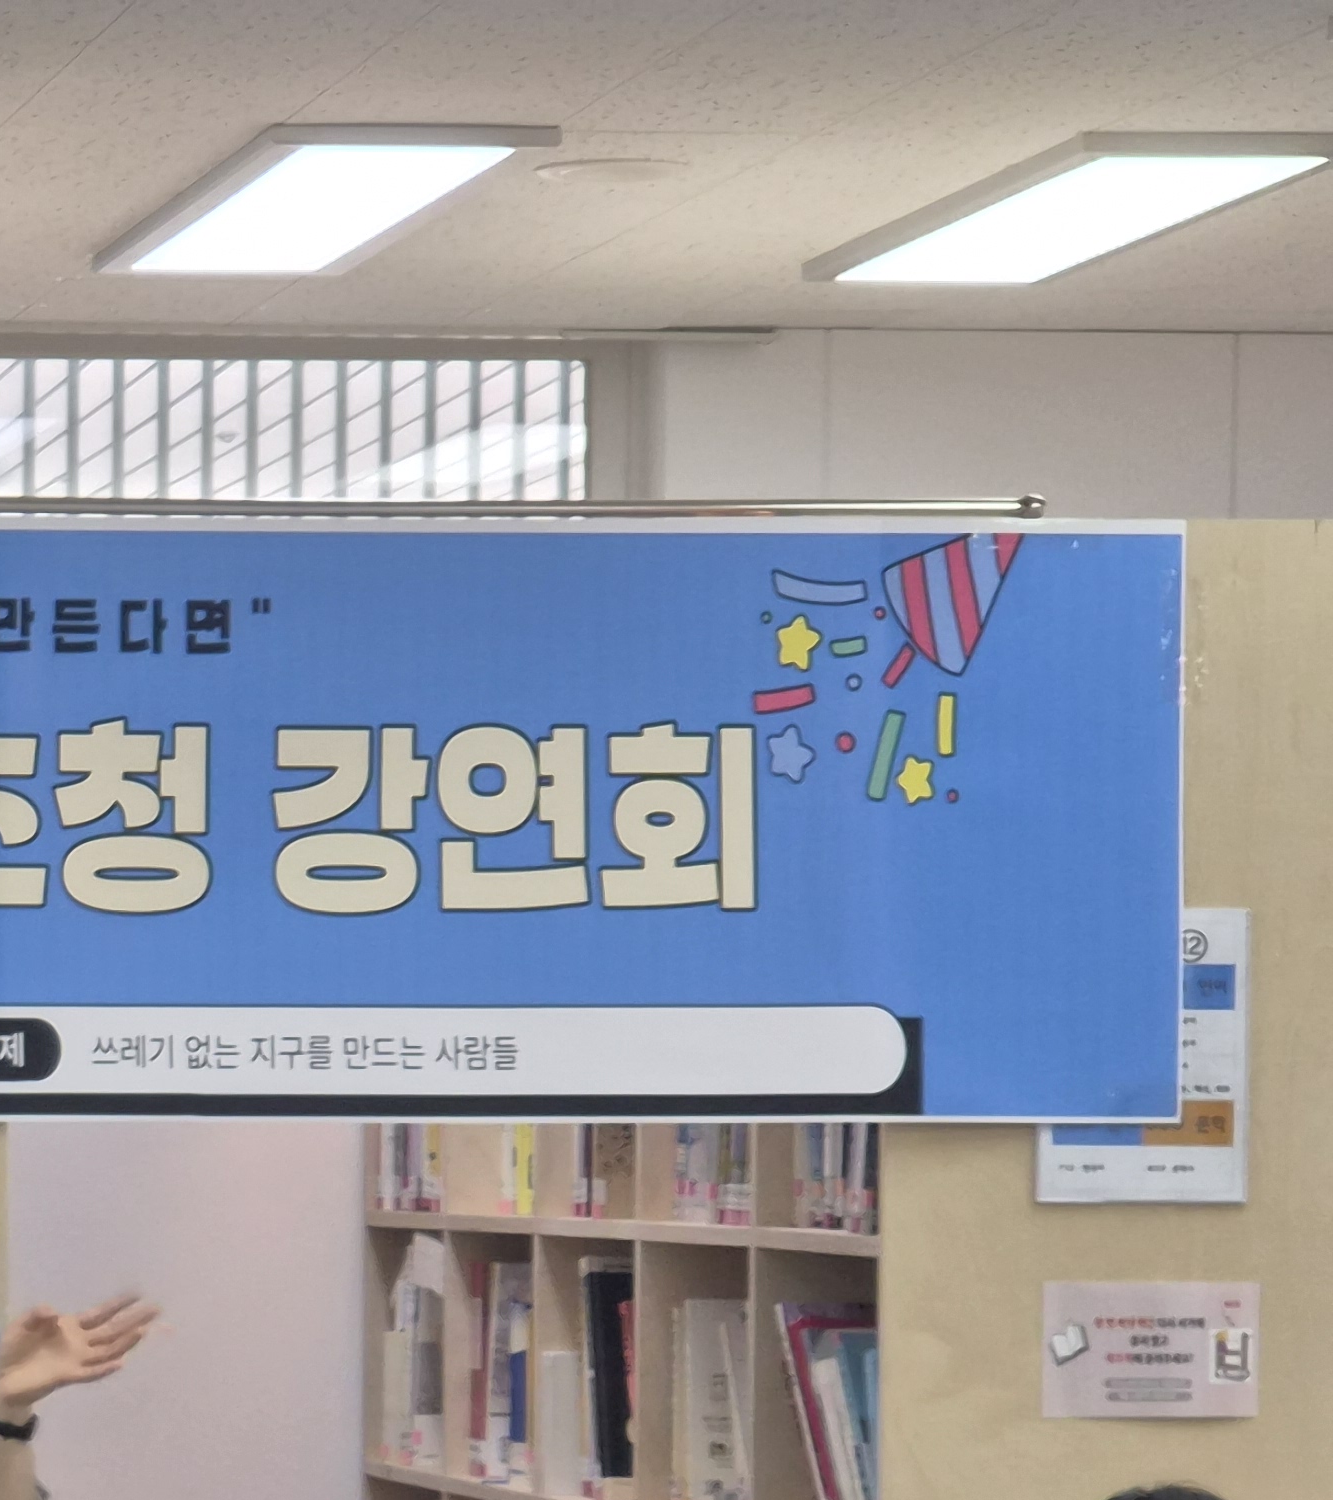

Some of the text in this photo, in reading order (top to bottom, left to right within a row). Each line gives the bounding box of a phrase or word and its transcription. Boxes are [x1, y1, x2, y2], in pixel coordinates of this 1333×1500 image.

[271, 719, 758, 914] 강연회
[91, 1035, 520, 1071] 쓰레기 없는 지구를 만드는 사람들
